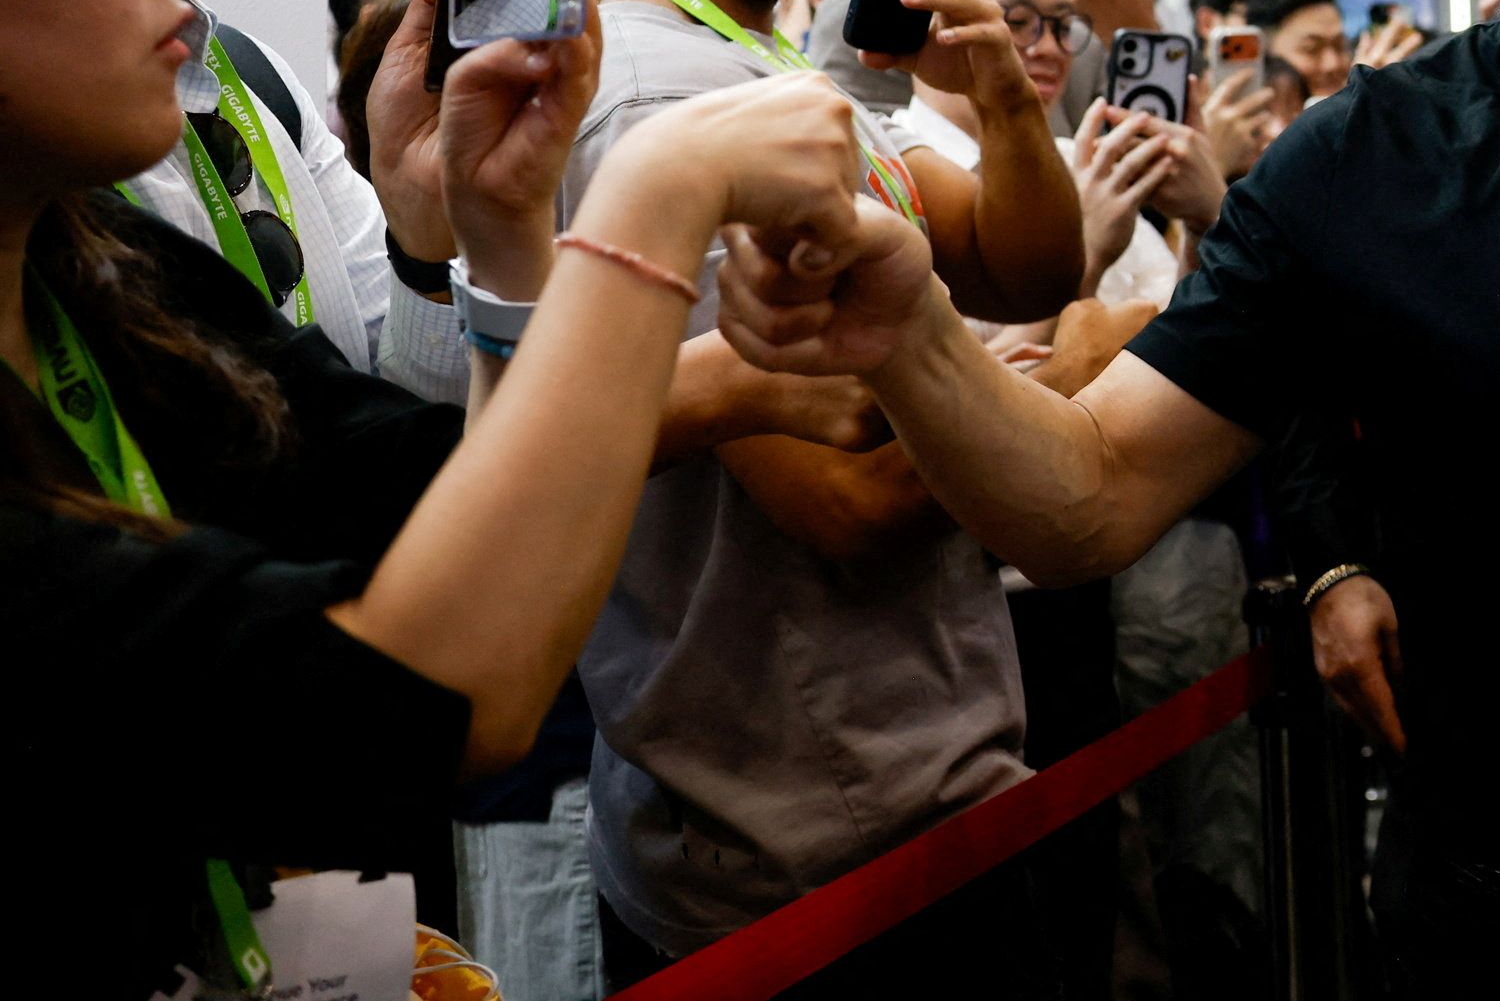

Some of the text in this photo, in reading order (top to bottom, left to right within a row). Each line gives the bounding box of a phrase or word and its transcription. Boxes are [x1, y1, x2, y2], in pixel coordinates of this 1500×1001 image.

[221, 83, 261, 144] GIGABYTE
[193, 152, 228, 221] GIGABYTE
[297, 291, 308, 326] GIGA
